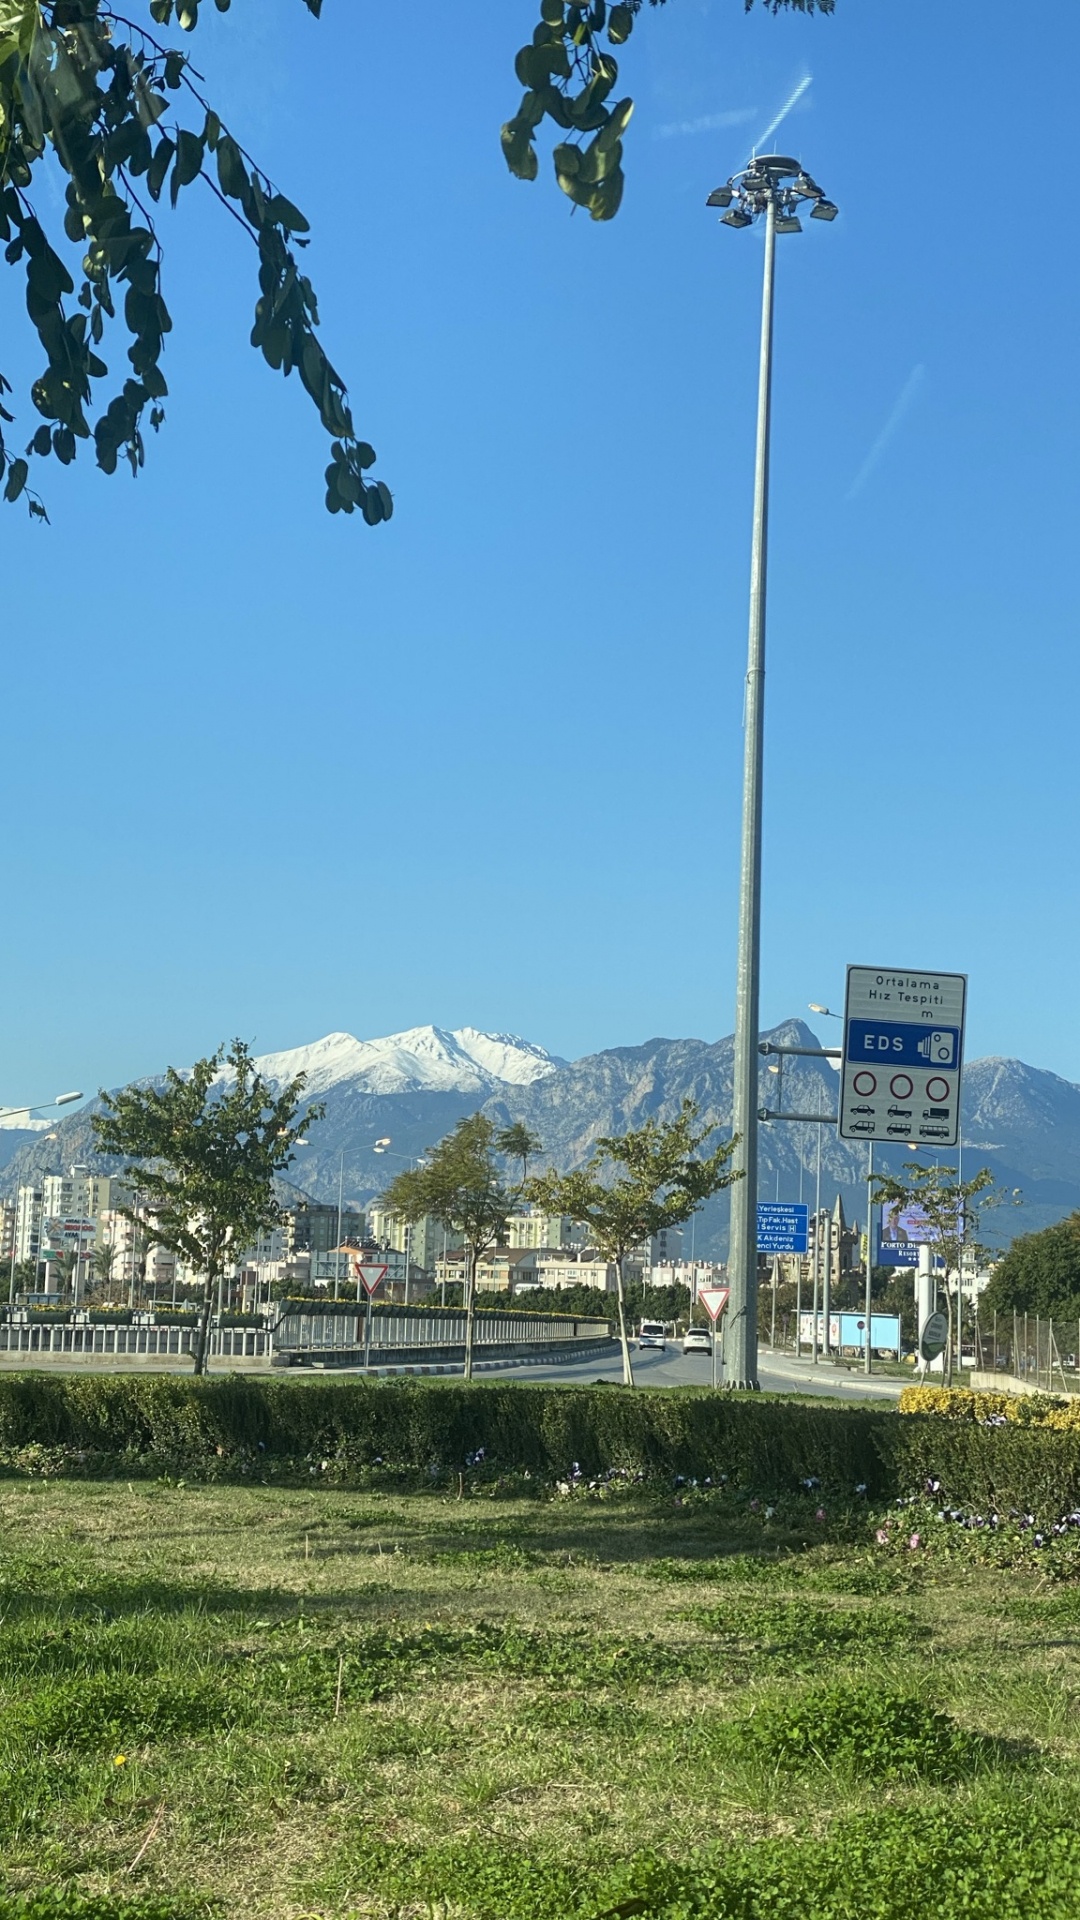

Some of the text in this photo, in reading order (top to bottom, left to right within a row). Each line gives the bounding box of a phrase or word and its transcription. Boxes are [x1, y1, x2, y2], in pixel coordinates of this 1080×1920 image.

[876, 975, 939, 990] Ortalama
[869, 990, 943, 1005] Hız Tespiti
[921, 1009, 933, 1018] m
[864, 1034, 904, 1051] EDS
[757, 1205, 794, 1213] .Yerleşkesi
